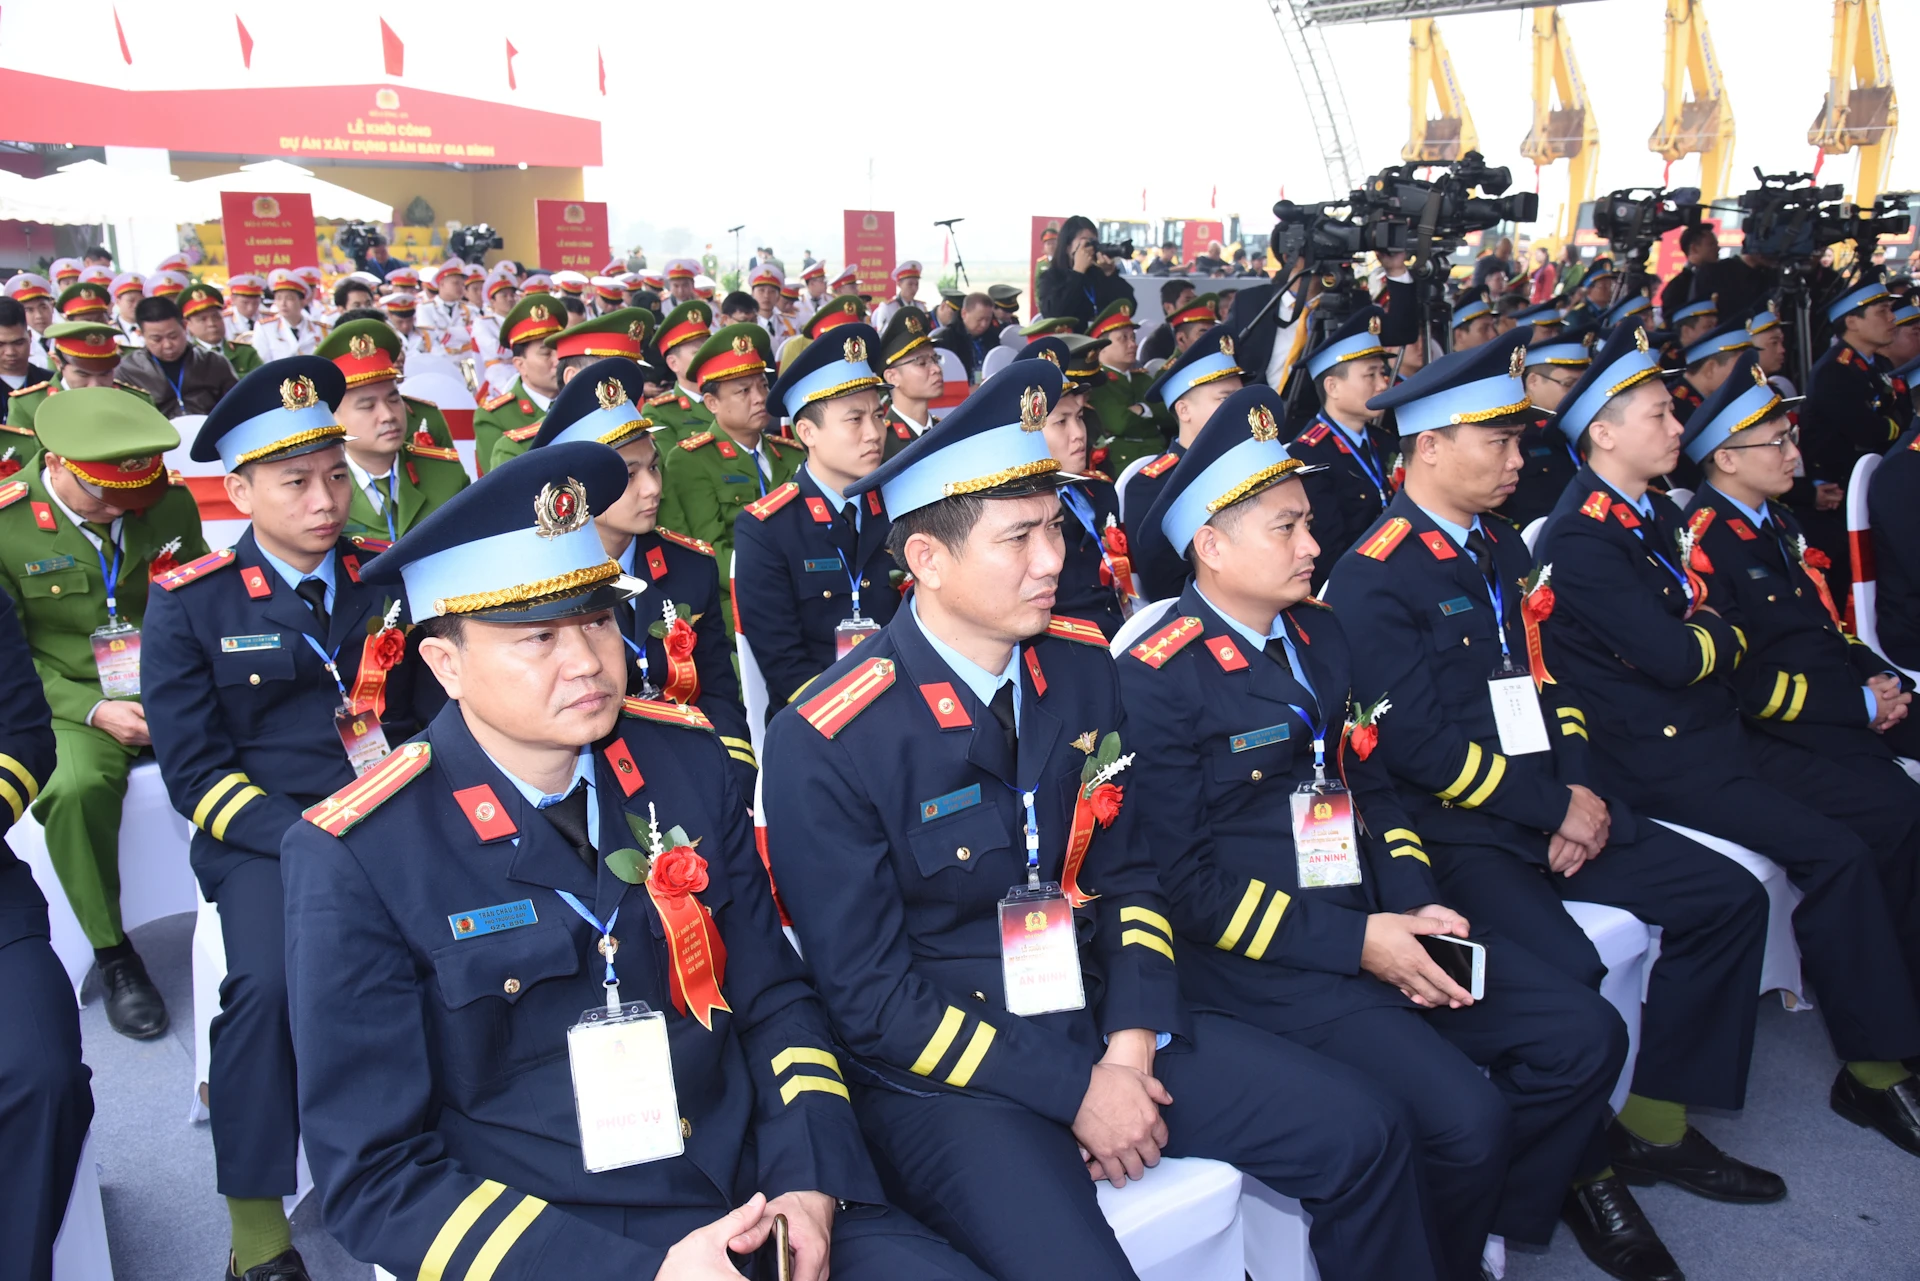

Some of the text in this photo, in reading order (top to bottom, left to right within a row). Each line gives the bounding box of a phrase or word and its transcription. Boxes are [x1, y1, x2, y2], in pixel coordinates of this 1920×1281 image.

[347, 118, 432, 138] LỄ KHỞI CÔNG
[279, 135, 495, 157] DỰ ÁN XÂY DỰNG SÂN BAY GIA BÌNH
[253, 252, 291, 268] DỰ ÁN
[1309, 853, 1347, 864] AN NINH
[1019, 971, 1067, 986] AN NINH
[641, 1107, 662, 1124] VỤ
